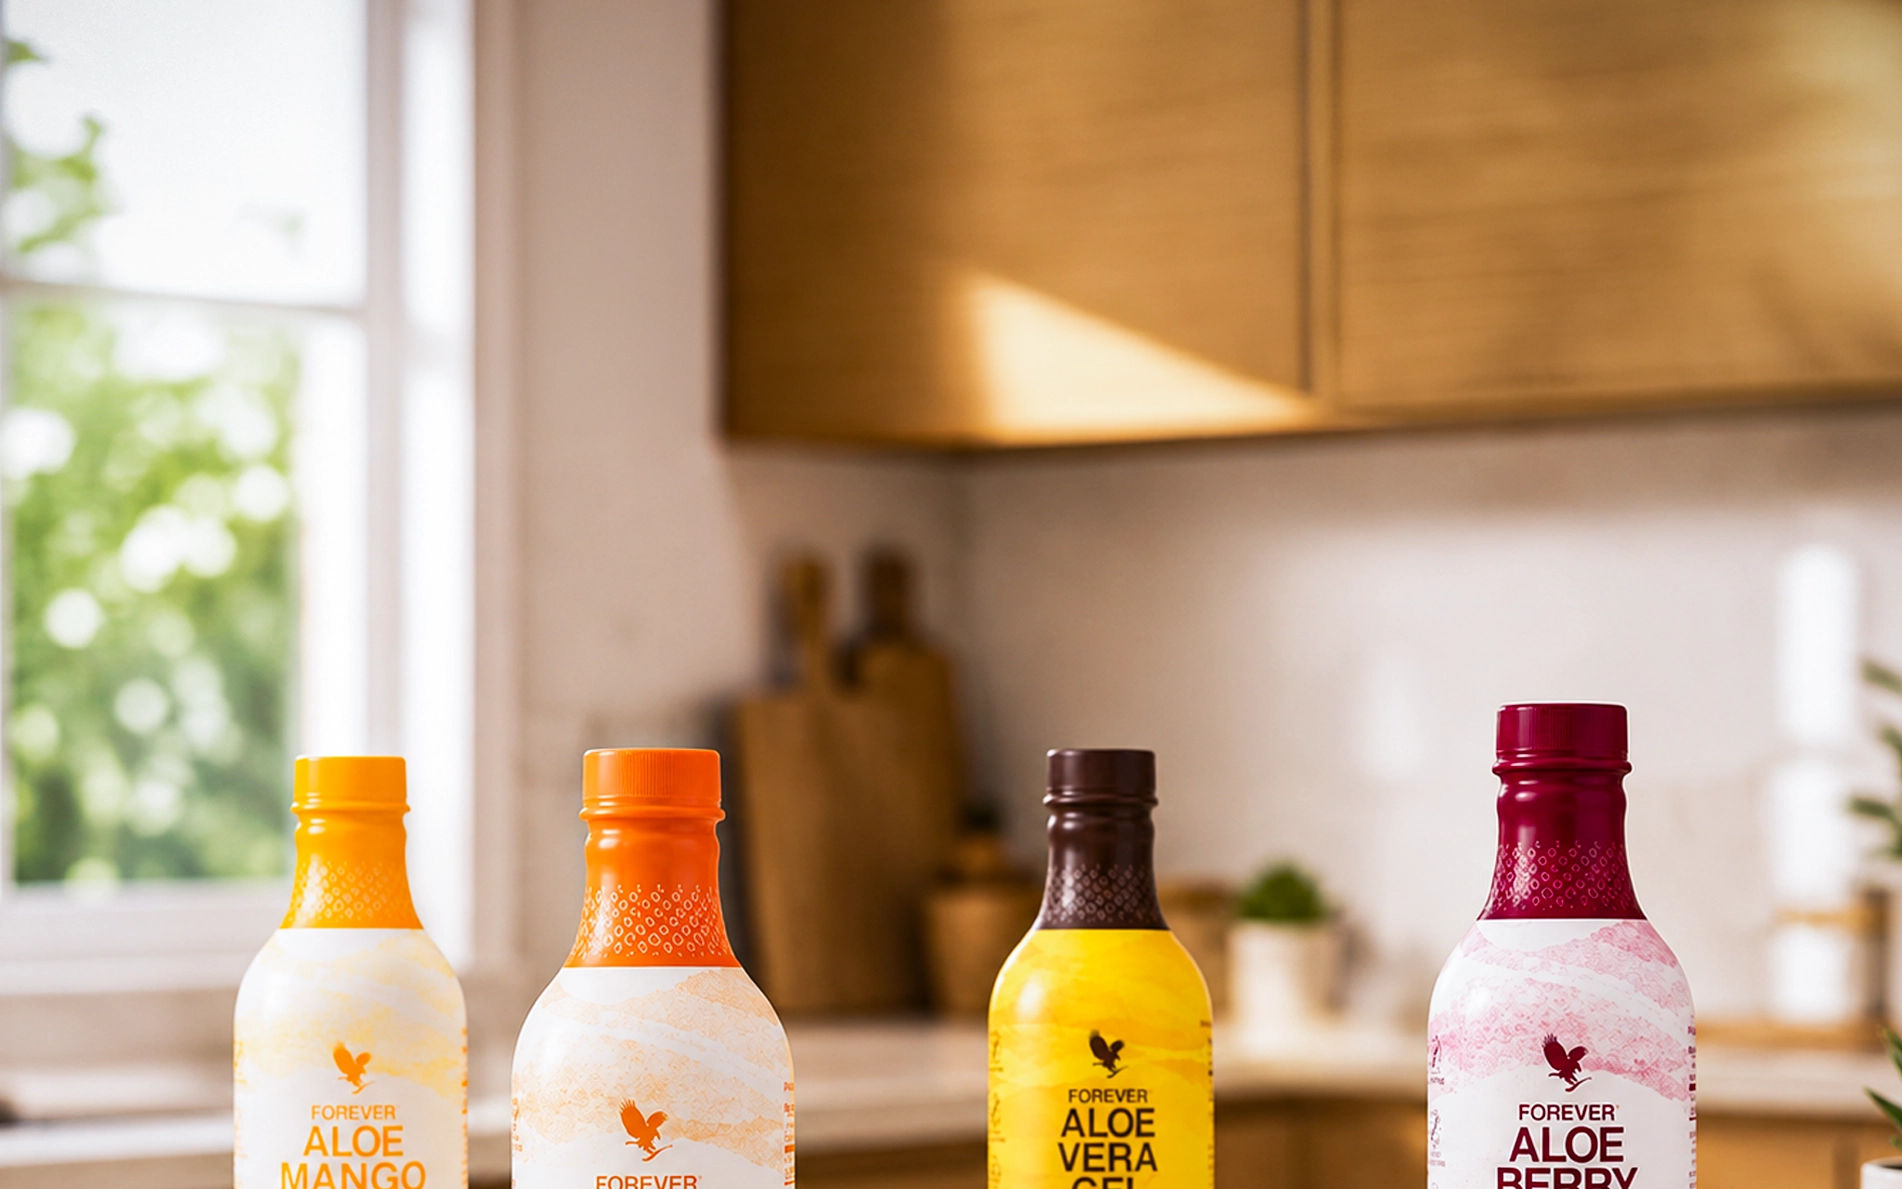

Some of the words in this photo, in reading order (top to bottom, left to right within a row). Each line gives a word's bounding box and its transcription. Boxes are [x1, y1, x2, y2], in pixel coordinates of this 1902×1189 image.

[1068, 1089, 1148, 1103] FOREVER
[311, 1105, 396, 1120] FOREVER
[1061, 1108, 1155, 1138] ALOE
[1518, 1104, 1615, 1121] FOREVER
[303, 1125, 404, 1157] ALOE
[1509, 1126, 1624, 1163] ALOE
[1058, 1142, 1158, 1172] VERA
